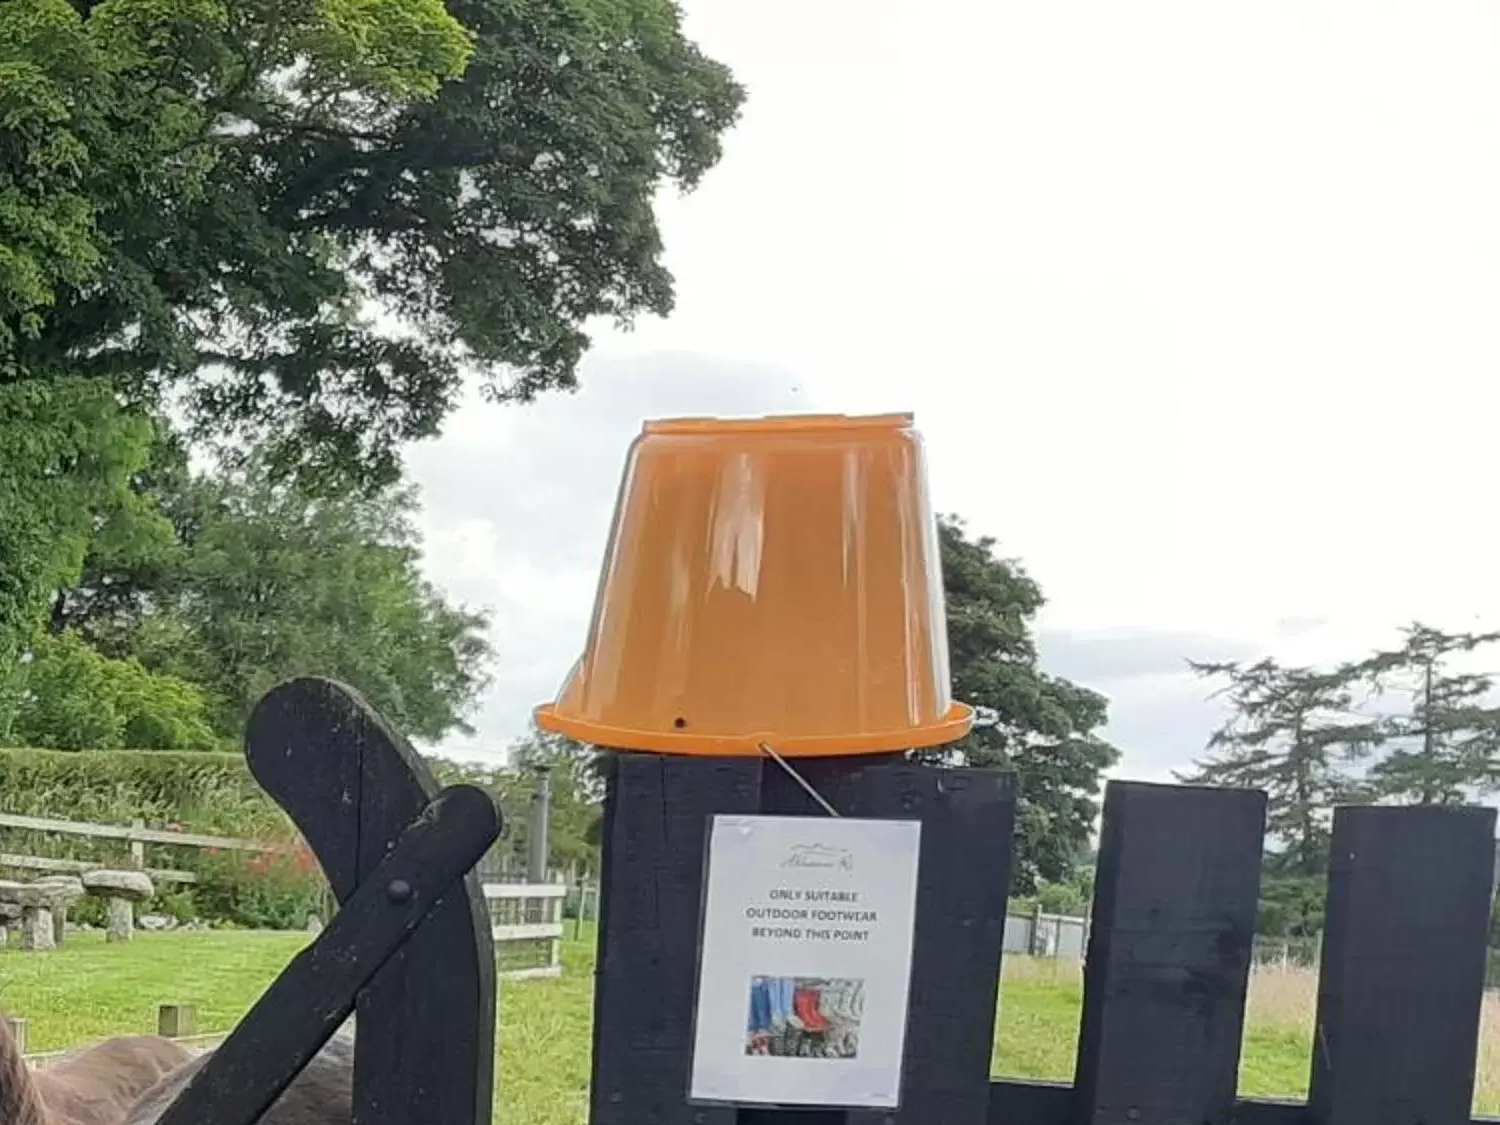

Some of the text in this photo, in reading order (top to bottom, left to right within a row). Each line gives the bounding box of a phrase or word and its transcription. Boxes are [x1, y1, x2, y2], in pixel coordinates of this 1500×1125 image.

[769, 889, 858, 902] ONLY SUITABLE
[746, 907, 877, 921] OUTDOOR FOOTWEAR
[752, 927, 869, 941] BEYOND THIS POINT
